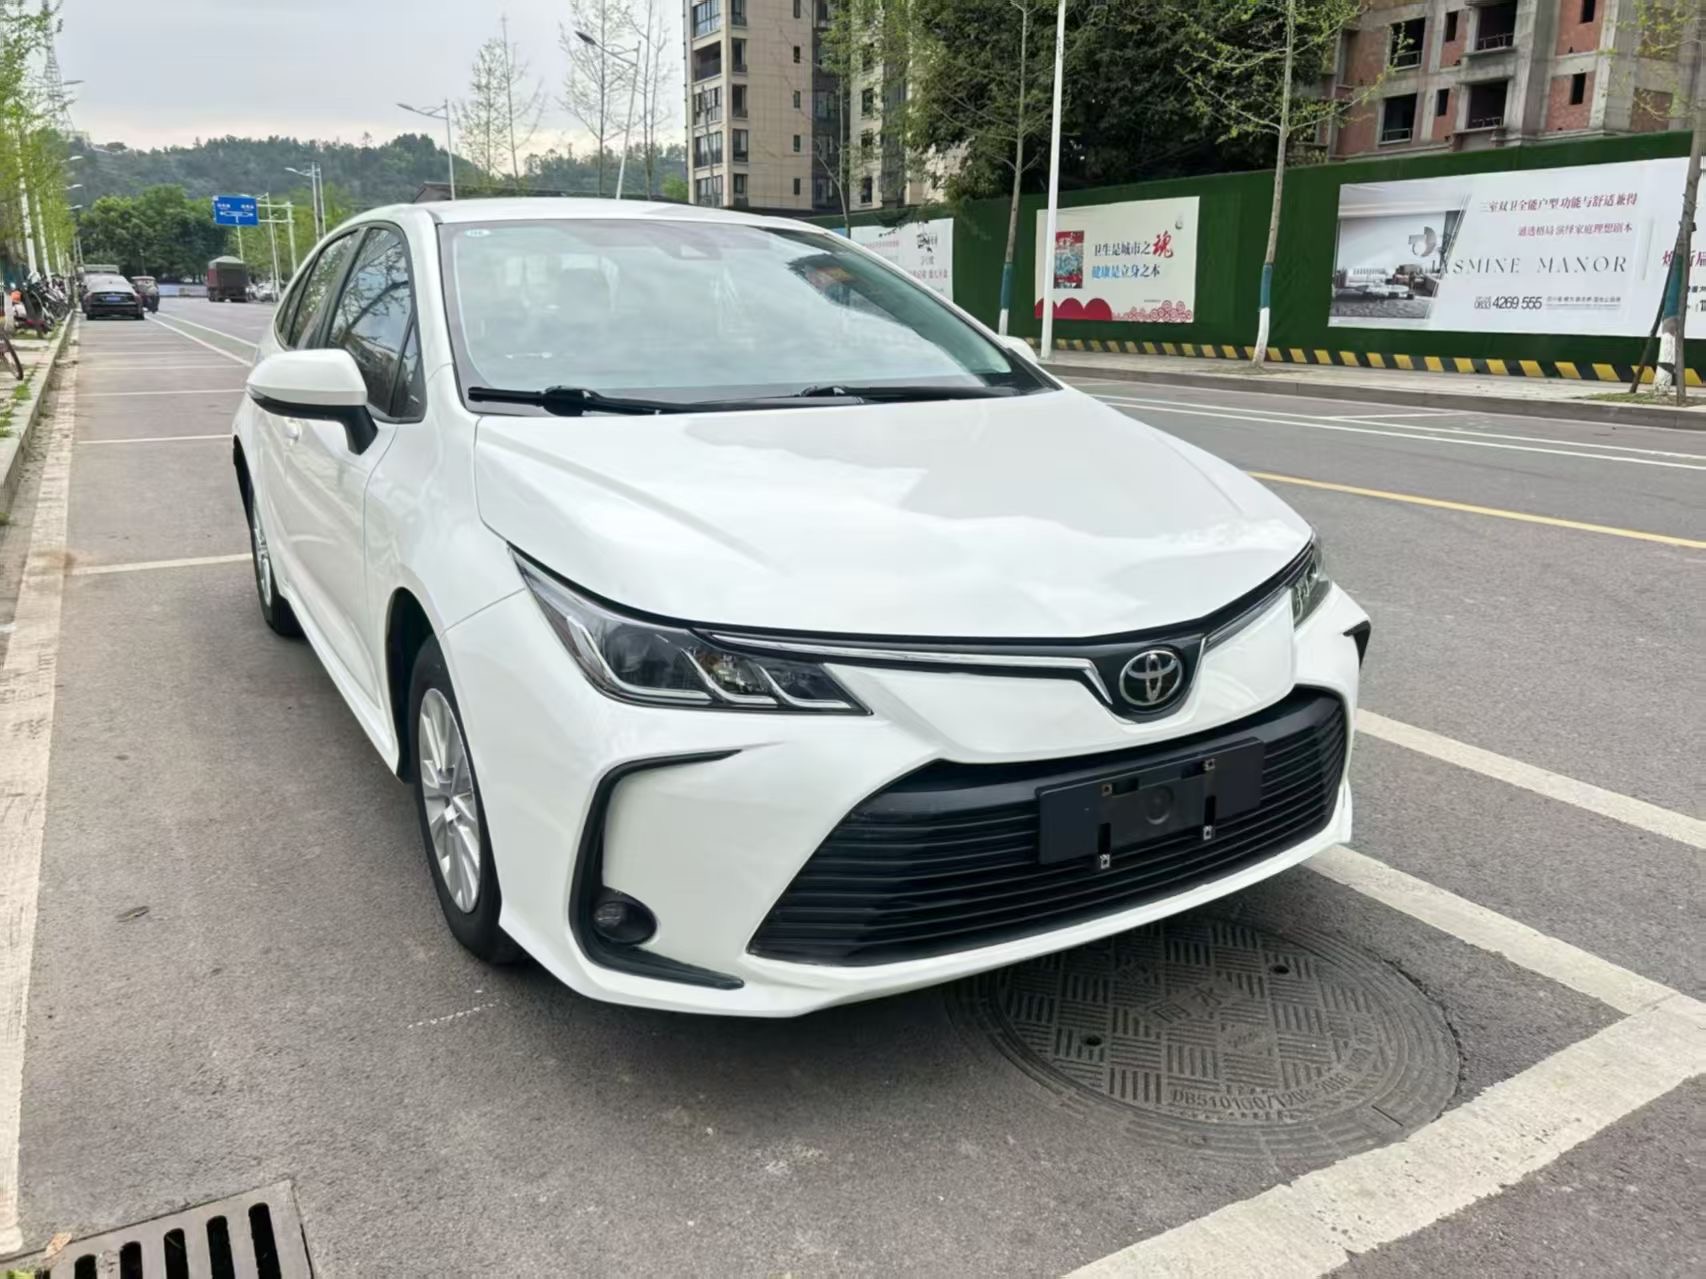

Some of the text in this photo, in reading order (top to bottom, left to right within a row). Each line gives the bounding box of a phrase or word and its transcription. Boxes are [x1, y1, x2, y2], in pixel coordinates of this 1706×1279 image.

[1092, 264, 1160, 278] 健康是立身之本
[1537, 256, 1627, 273] MANOR
[1492, 296, 1519, 310] 4269
[1521, 296, 1542, 310] 555
